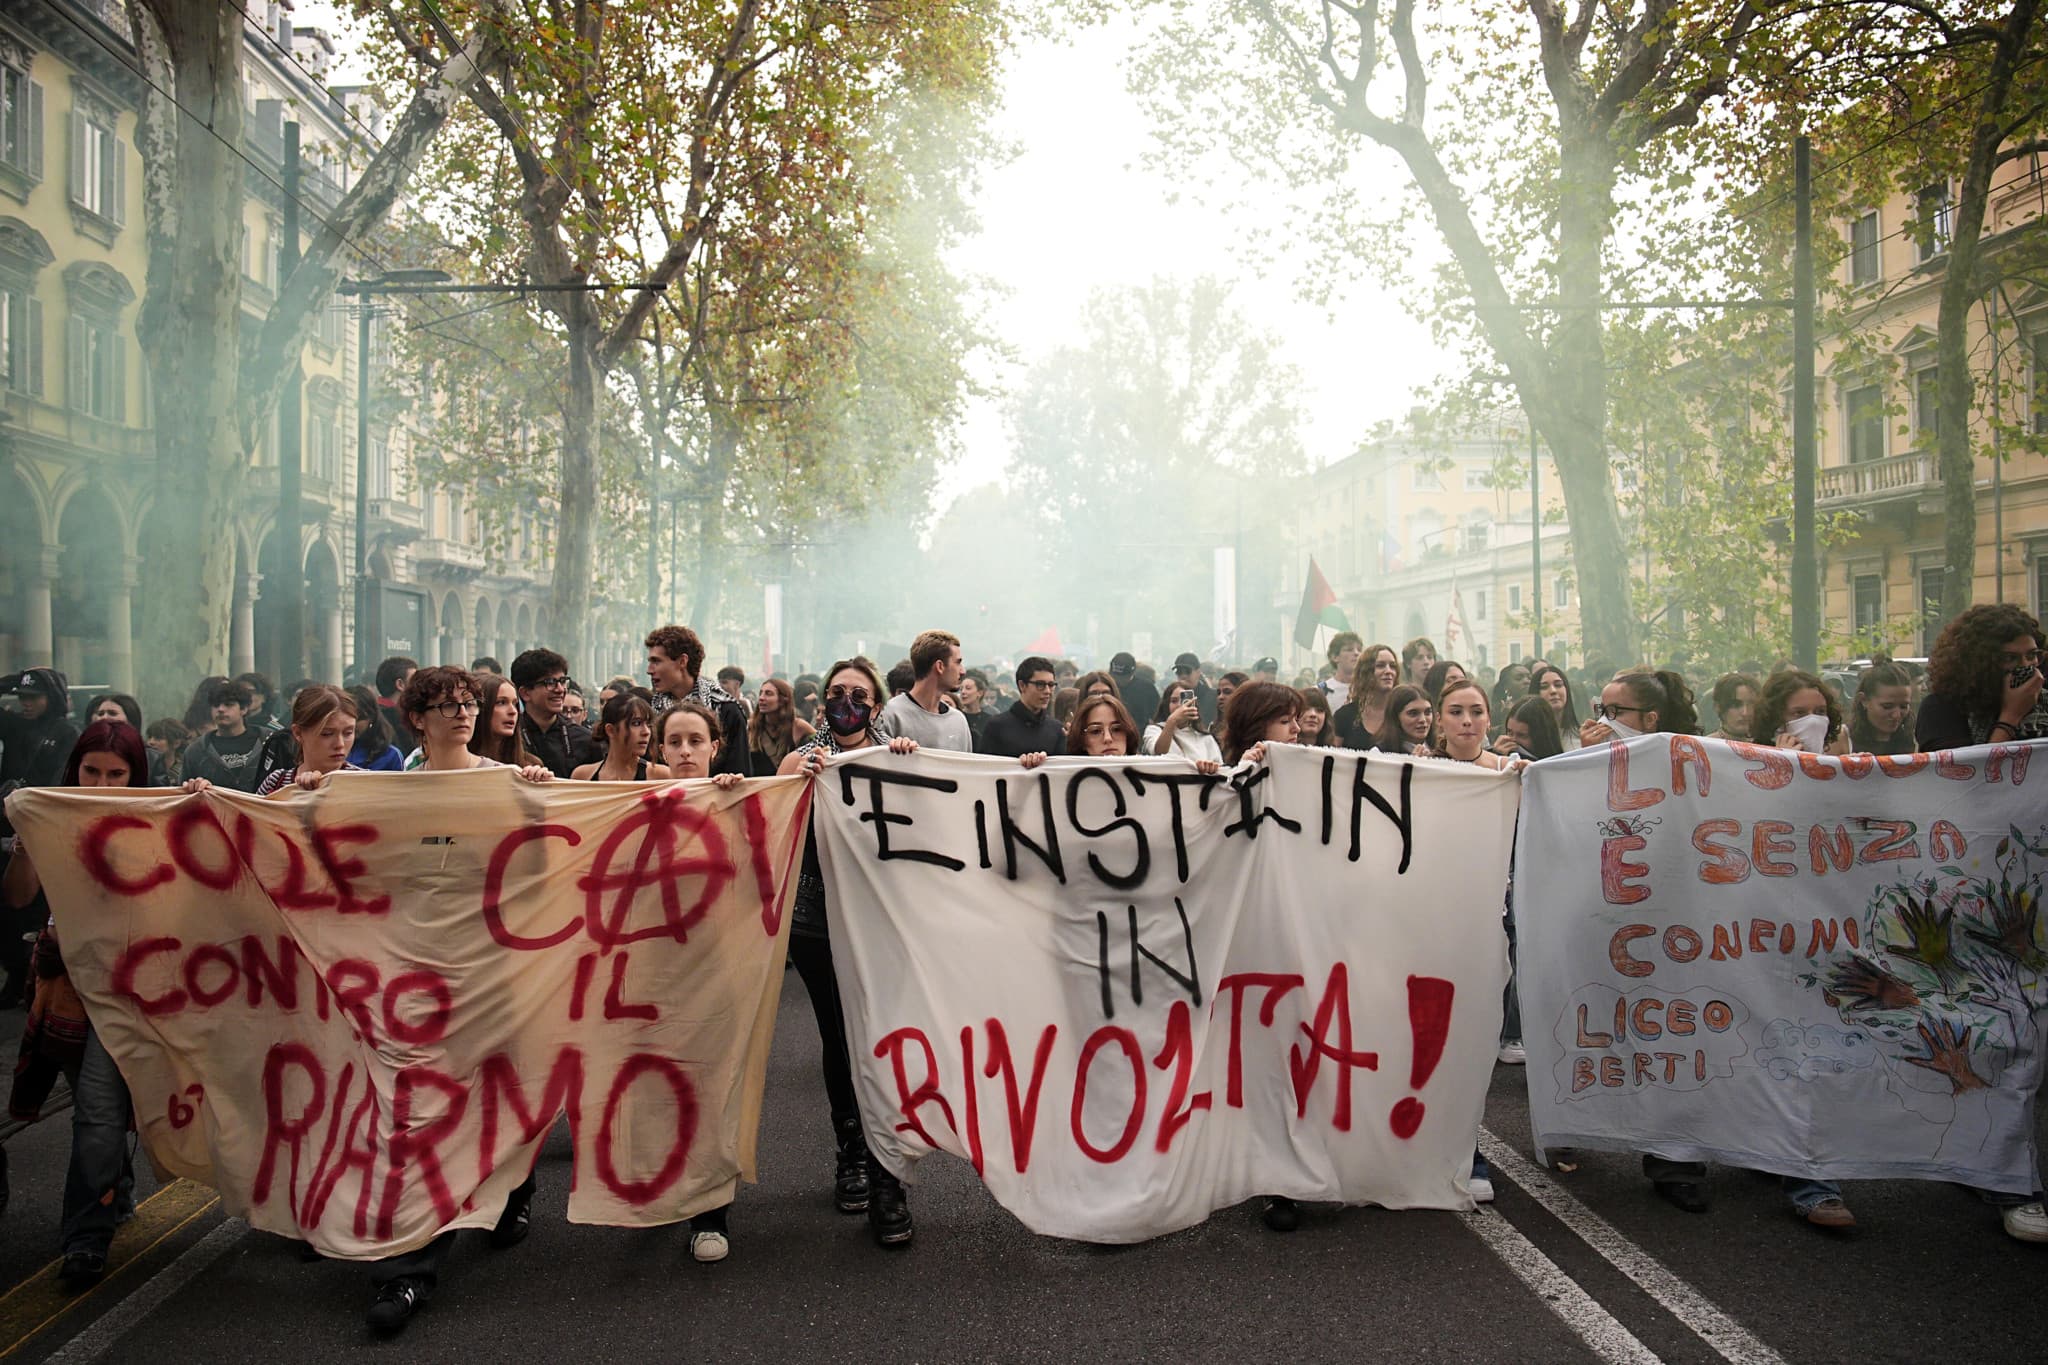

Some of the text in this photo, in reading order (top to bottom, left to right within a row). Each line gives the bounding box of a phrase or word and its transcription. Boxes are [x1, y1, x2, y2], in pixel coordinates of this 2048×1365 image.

[1606, 733, 1712, 811] LA
[1692, 816, 1967, 884] SENZA
[1096, 896, 1203, 1020] IN
[1608, 916, 1859, 978] CONFINI
[568, 951, 660, 1022] IL
[1576, 996, 1734, 1049] LICEO
[1571, 1049, 1707, 1093] BERTI
[251, 1042, 699, 1243] RIARMO
